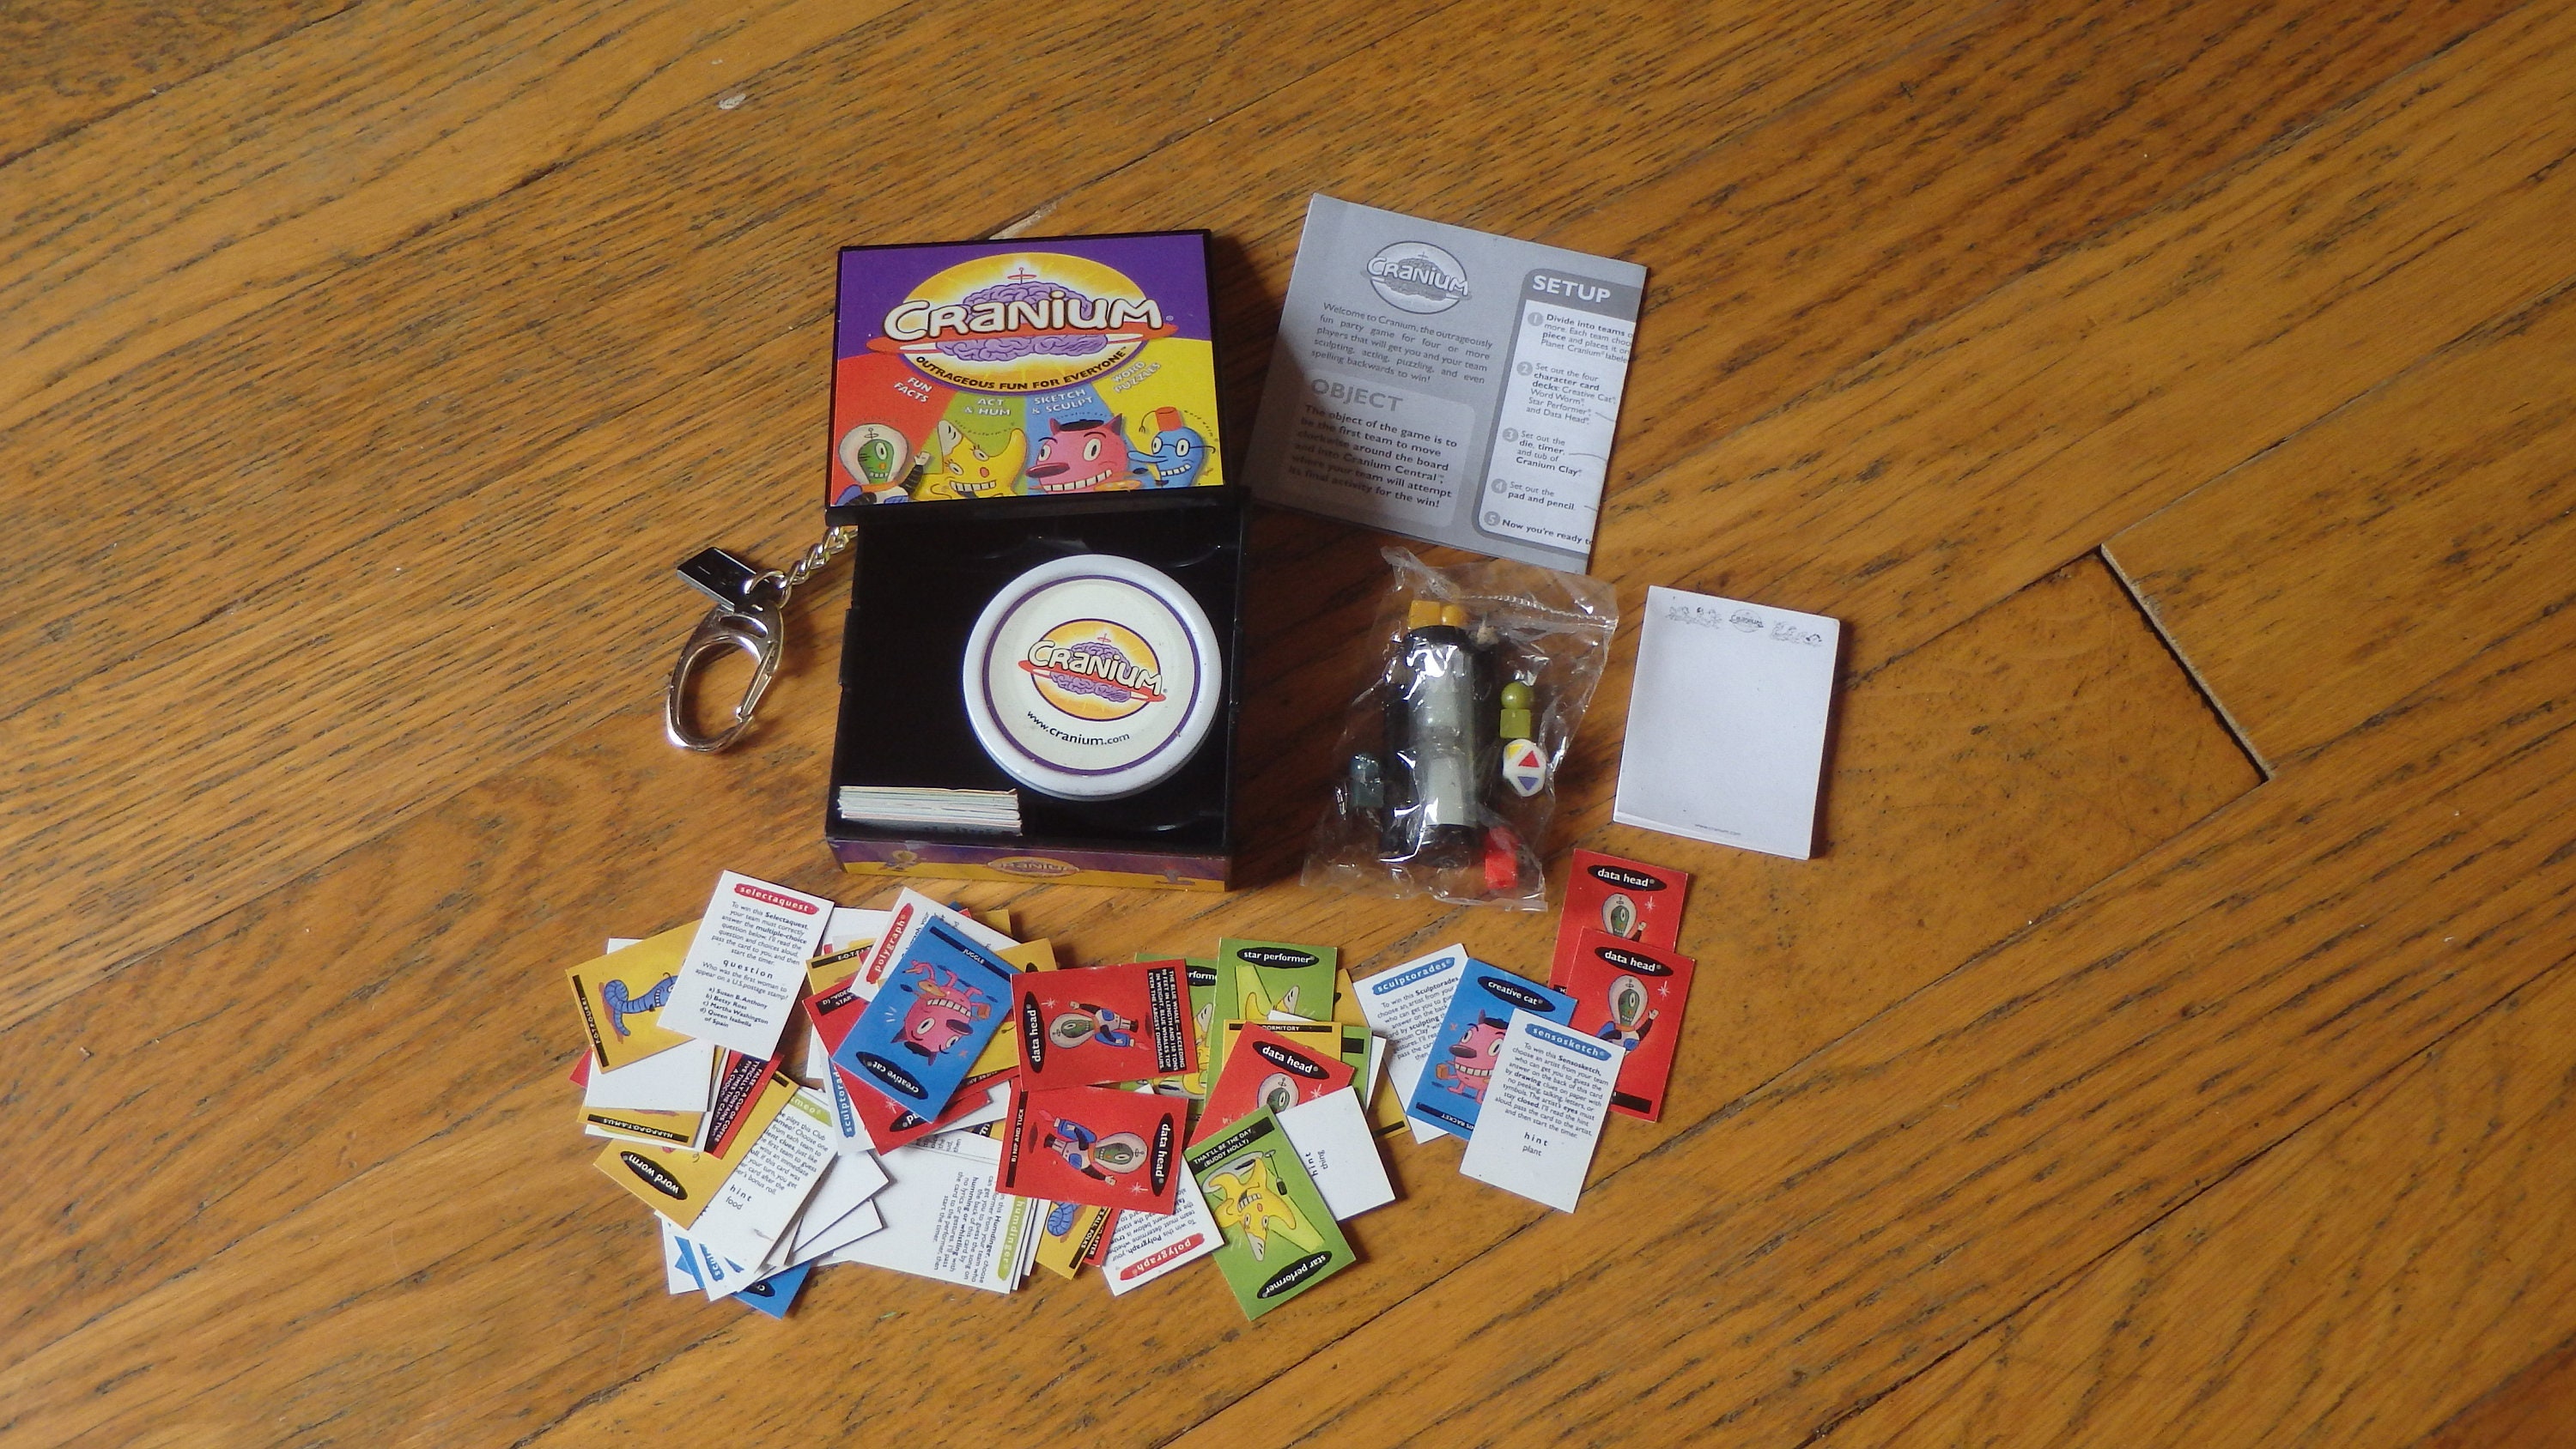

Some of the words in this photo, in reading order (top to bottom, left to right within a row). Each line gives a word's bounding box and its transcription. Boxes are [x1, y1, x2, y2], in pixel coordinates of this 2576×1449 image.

[1533, 275, 1610, 302] SETUP
[1546, 313, 1574, 324] Divide
[1577, 320, 1595, 329] into
[1598, 325, 1625, 336] teams
[1320, 313, 1334, 324] fun
[1340, 320, 1364, 332] party
[1370, 328, 1394, 337] game
[1401, 332, 1415, 342] for
[1422, 337, 1441, 349] four
[1465, 349, 1490, 359] more
[916, 356, 995, 391] OUTRAGEOUS
[999, 381, 1029, 391] FUN
[1033, 377, 1060, 389] FOR
[1063, 349, 1124, 385] EVERYONE
[1111, 361, 1145, 382] WORD
[1114, 363, 1160, 392] PUZZLES
[893, 382, 928, 403] FACTS
[907, 376, 933, 392] FUN
[1534, 373, 1577, 385] character
[1579, 382, 1599, 391] card
[1034, 389, 1086, 404] SKETCH
[1046, 397, 1093, 412] SCULPT
[1309, 377, 1403, 414] OBJECT
[979, 407, 1011, 415] HUM
[1326, 409, 1361, 424] object
[1379, 422, 1397, 433] the
[1400, 429, 1430, 440] game
[1434, 435, 1442, 444] is
[1502, 518, 1523, 529] Now
[1526, 526, 1553, 535] you're
[1556, 532, 1582, 543] ready
[1027, 711, 1130, 746] www.cranium.com
[1597, 868, 1619, 880] data
[1623, 873, 1648, 886] head
[739, 885, 809, 912] selectaquest
[755, 925, 806, 943] multiple-choice
[872, 918, 905, 973] polygraph
[961, 949, 984, 963] JUGGLE
[1263, 953, 1310, 962] performer
[1604, 950, 1626, 963] data
[1630, 957, 1655, 971] head
[723, 960, 772, 979] question
[1376, 959, 1447, 992] sculptorades
[713, 995, 730, 1005] Betsy
[732, 1001, 746, 1009] Ross
[1488, 981, 1521, 998] creative
[1523, 995, 1537, 1004] cat
[1027, 1009, 1037, 1035] head
[1409, 1016, 1439, 1030] sculpting
[1031, 1038, 1041, 1062] data
[1176, 1032, 1185, 1067] EXCEEDING
[1532, 1027, 1600, 1056] sensosketch
[741, 1060, 751, 1072] FIVE
[872, 1061, 885, 1071] cat
[1262, 1046, 1284, 1061] data
[1286, 1055, 1312, 1073] head
[730, 1074, 744, 1089] TIMES
[738, 1060, 760, 1090] TYPICALLY
[749, 1068, 762, 1086] FALSE
[887, 1070, 918, 1092] creative
[1514, 1071, 1540, 1086] drawing
[719, 1090, 740, 1120] CONTAINS
[722, 1091, 733, 1102] THE
[734, 1098, 743, 1111] CUP
[729, 1111, 735, 1119] OF
[1441, 1113, 1465, 1126] RACKET
[714, 1119, 730, 1142] COFFEE
[1159, 1124, 1170, 1147] data
[1524, 1131, 1547, 1146] hint
[1194, 1148, 1218, 1163] THAT'LL
[1226, 1136, 1238, 1144] THE
[1238, 1128, 1251, 1138] DAY
[1204, 1150, 1225, 1167] (BUDDY
[1226, 1138, 1249, 1153] HOLLY)
[1522, 1145, 1541, 1155] plant
[629, 1154, 654, 1176] worm
[1155, 1150, 1167, 1177] head
[1305, 1152, 1317, 1177] hint
[1317, 1149, 1327, 1169] thing
[653, 1173, 678, 1193] word
[729, 1184, 751, 1201] hint
[725, 1195, 743, 1210] food
[963, 1177, 978, 1211] humming
[963, 1213, 968, 1222] or
[951, 1223, 965, 1255] whistling
[1001, 1199, 1024, 1262] humdinger
[1078, 1228, 1094, 1248] FOLKS
[1135, 1239, 1192, 1272] polygraph
[1309, 1254, 1325, 1268] star
[1265, 1263, 1307, 1295] performer
